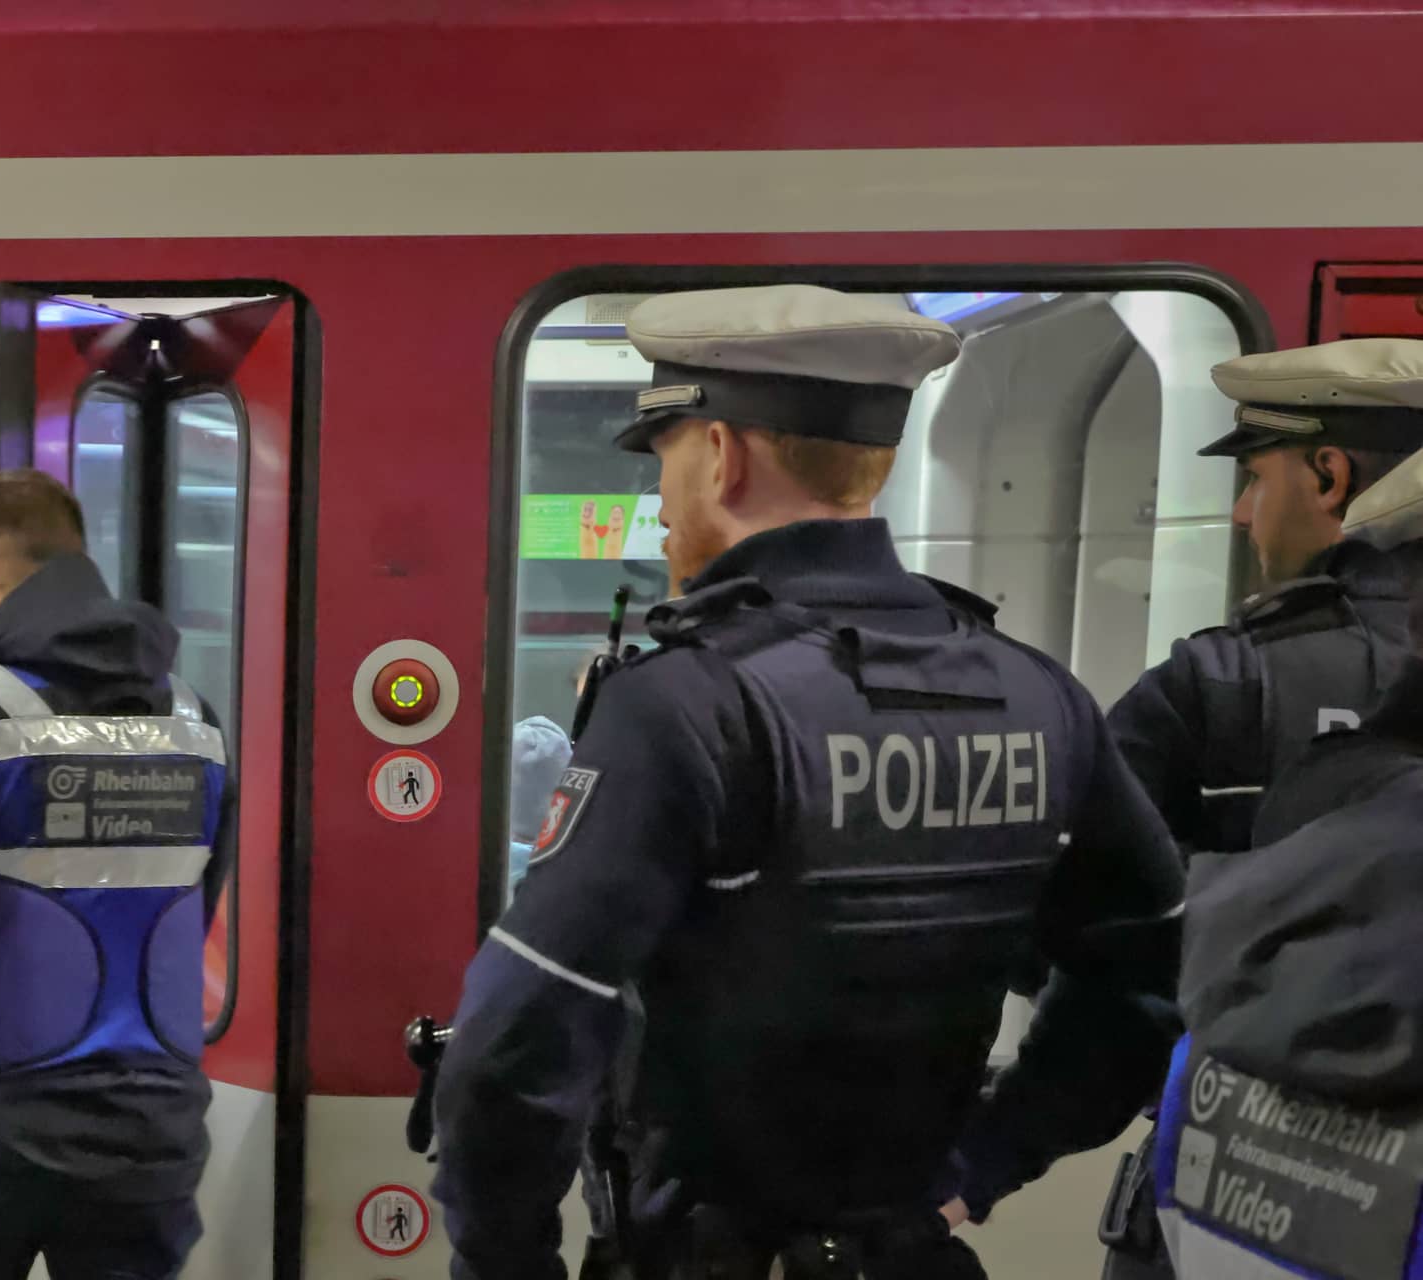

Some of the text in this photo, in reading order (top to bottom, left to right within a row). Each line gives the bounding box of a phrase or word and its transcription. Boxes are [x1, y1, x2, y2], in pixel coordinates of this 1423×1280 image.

[93, 769, 196, 791] Rheinbahn
[827, 731, 1047, 830] POLIZEI
[91, 815, 153, 839] Video
[1238, 1078, 1406, 1166] Rheinbahn
[1213, 1169, 1292, 1243] Video
